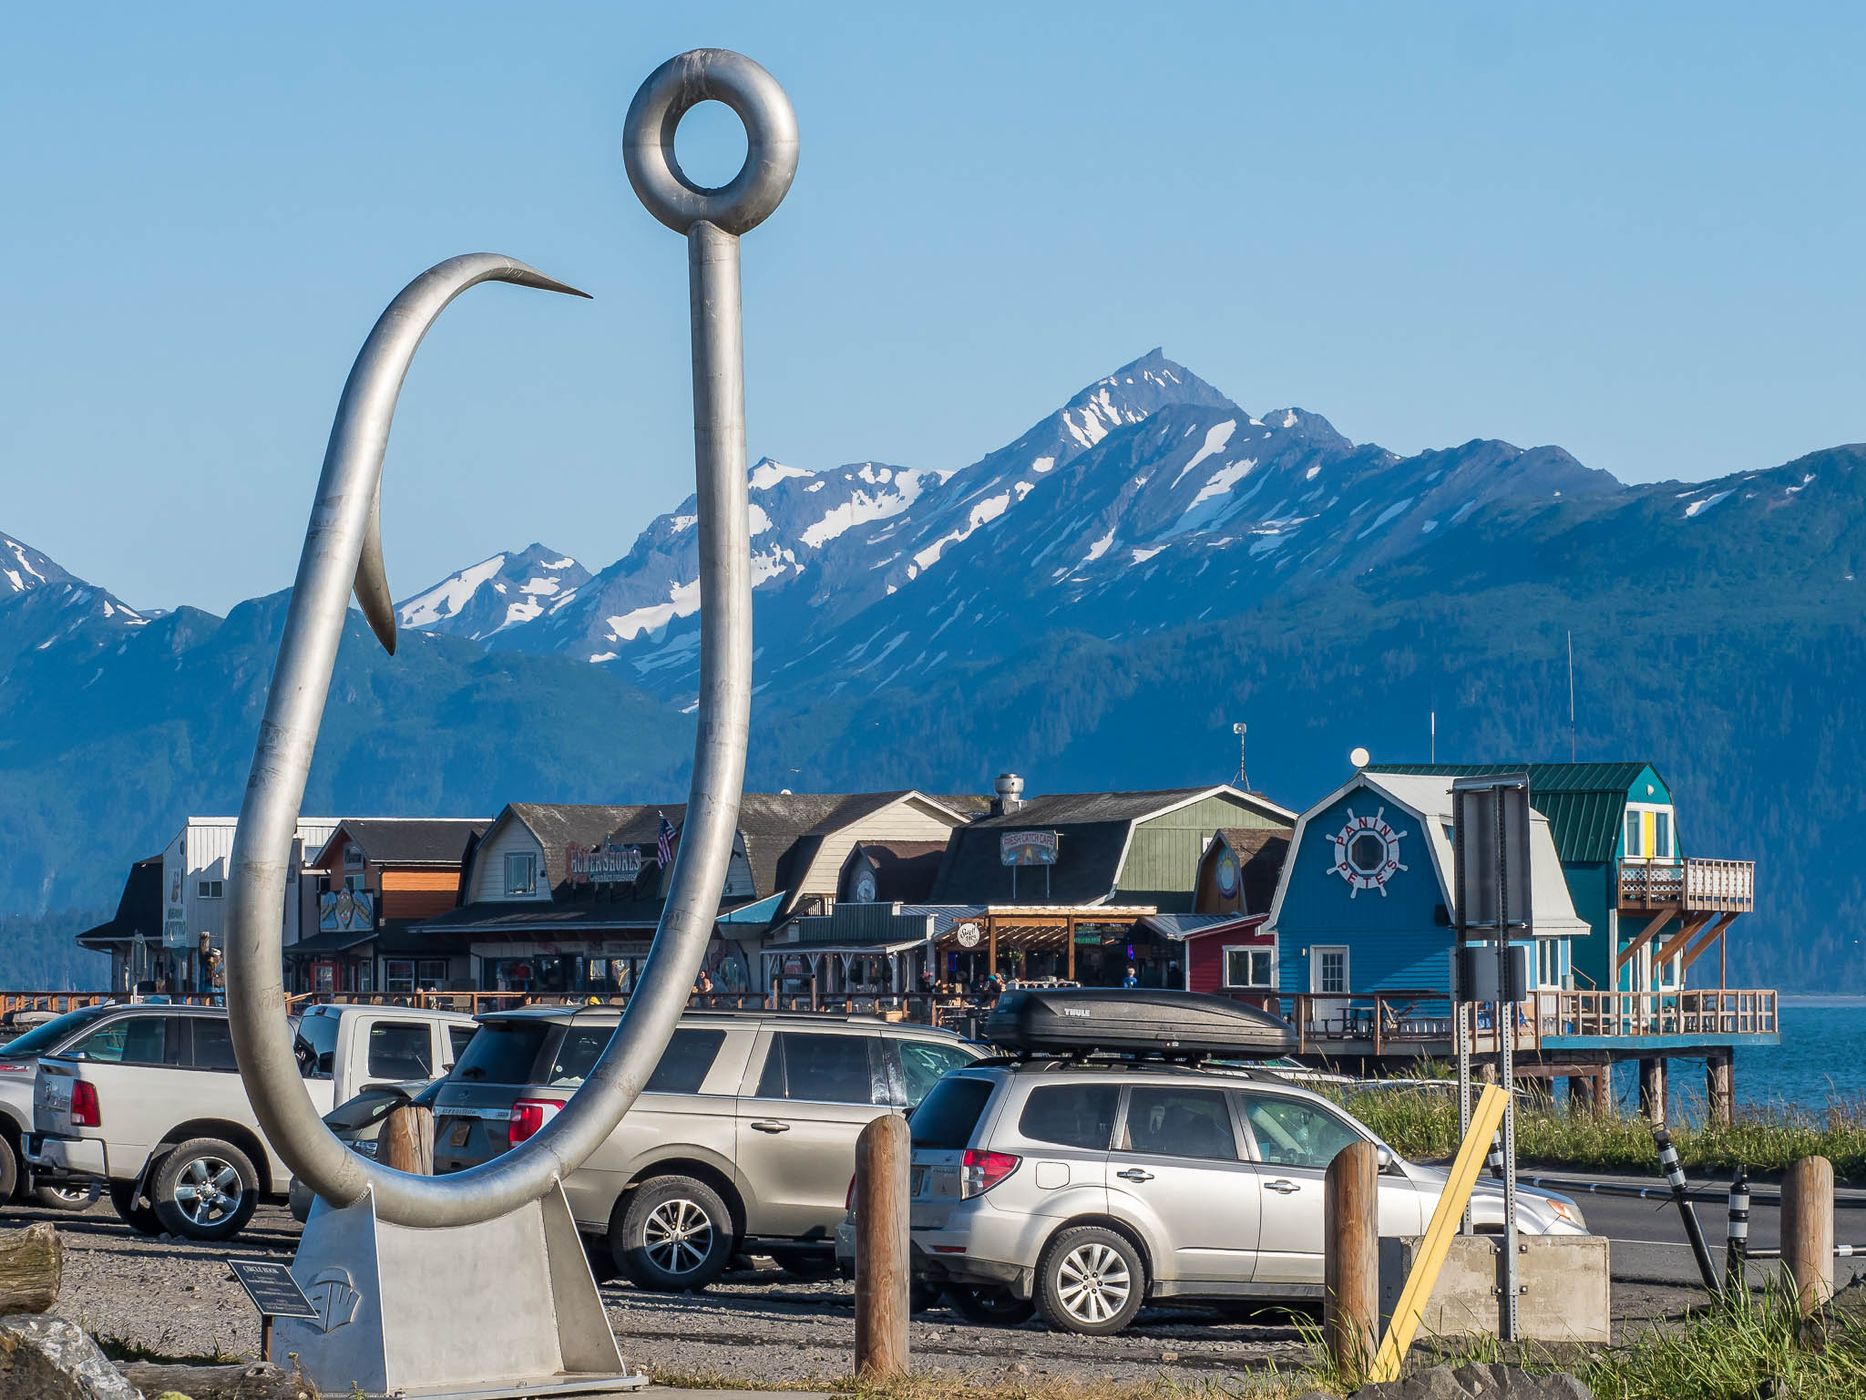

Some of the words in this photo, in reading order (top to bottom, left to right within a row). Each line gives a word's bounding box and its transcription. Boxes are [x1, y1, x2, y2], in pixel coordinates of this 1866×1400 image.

[1336, 816, 1398, 847] PANINI
[1337, 859, 1398, 889] PETE'S
[1064, 1007, 1091, 1017] THULE
